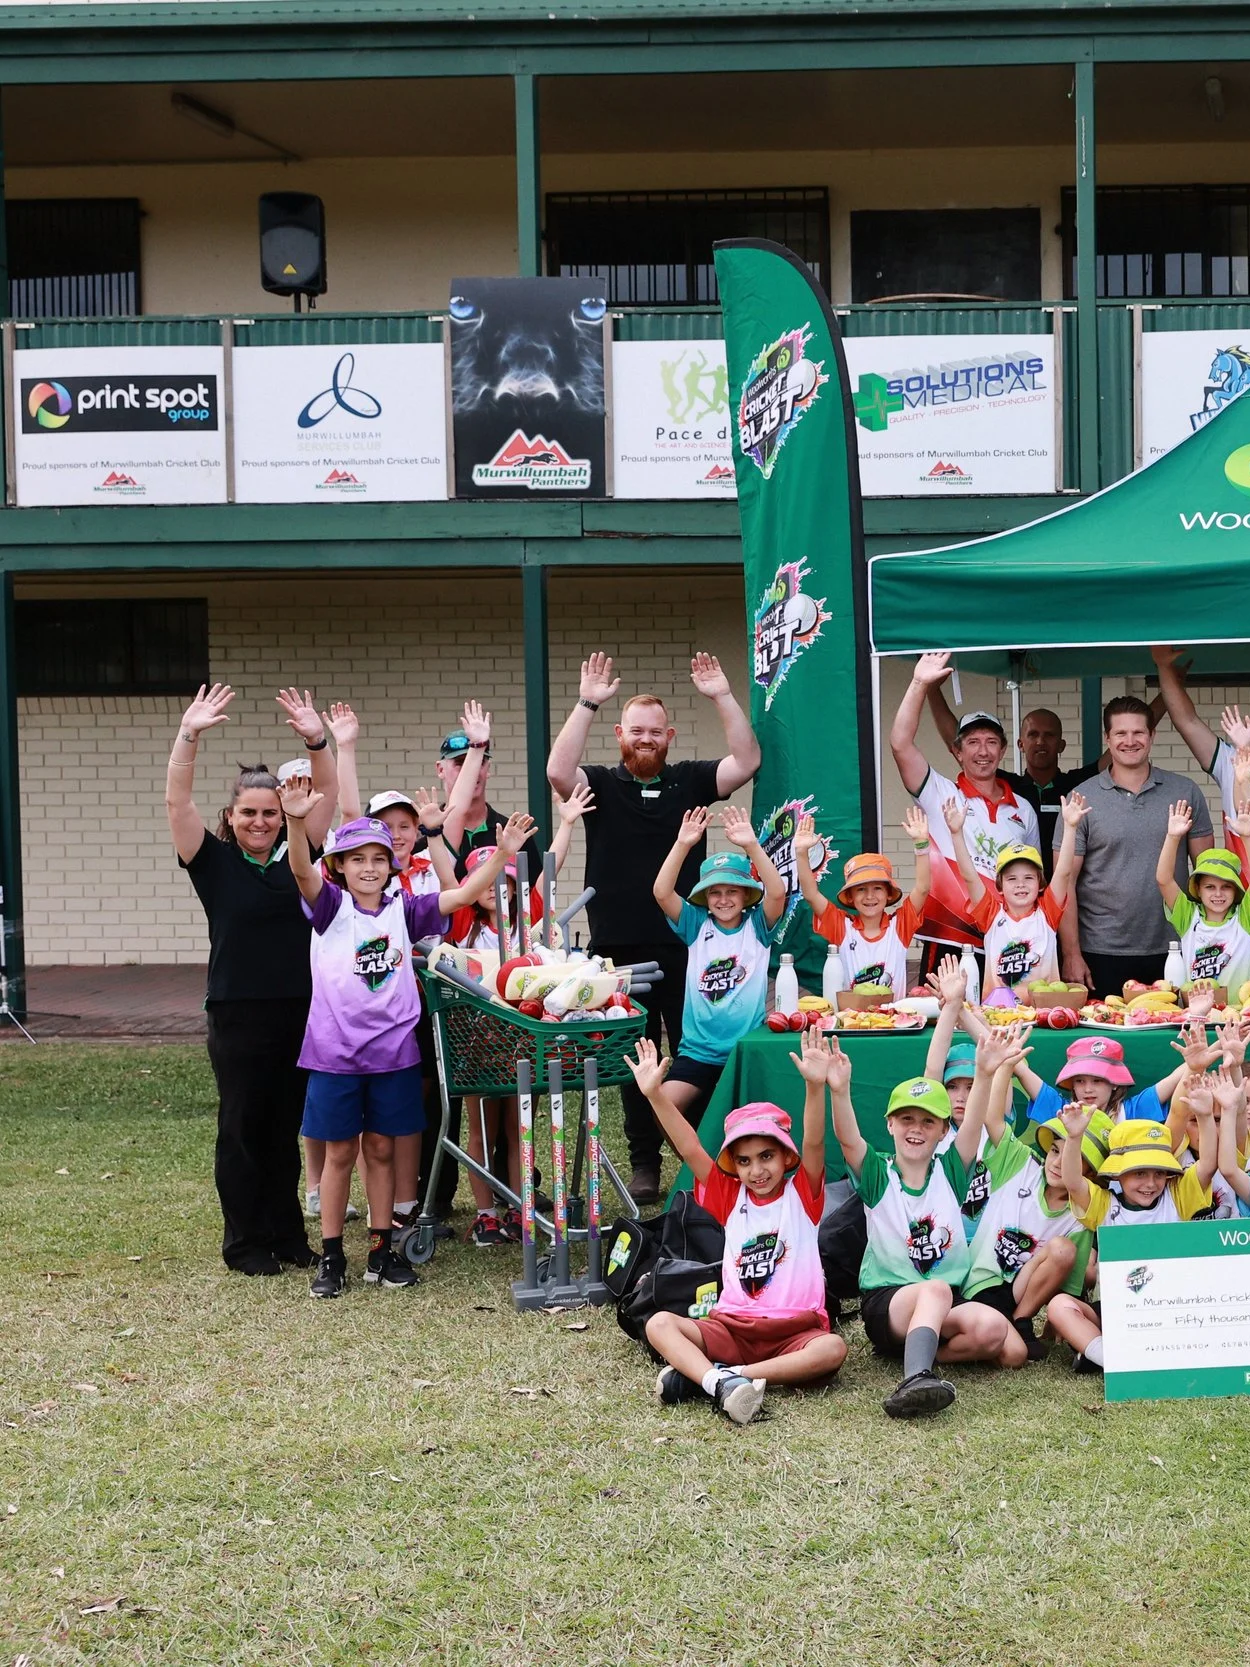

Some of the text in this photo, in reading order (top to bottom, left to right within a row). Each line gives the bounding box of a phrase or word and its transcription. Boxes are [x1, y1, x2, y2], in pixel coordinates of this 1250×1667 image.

[886, 357, 1044, 396] SOLUTIONS
[744, 372, 787, 419] CRICKET
[902, 372, 1047, 410] MEDICAL
[77, 383, 210, 415] print spot
[168, 409, 210, 423] group
[889, 393, 1048, 424] QUALITY PRECISION TECHNOLOGY
[740, 384, 803, 451] BLAST
[297, 432, 381, 440] MURWILLUMBAH
[656, 427, 703, 440] Pace
[621, 455, 647, 463] Proud
[649, 455, 691, 463] sponsors
[693, 454, 701, 462] of
[873, 451, 914, 460] sponsors
[916, 450, 925, 458] of
[927, 450, 991, 458] Murwillumbah
[993, 449, 1026, 457] Cricket
[1028, 448, 1048, 457] Club
[22, 459, 221, 470] Proud sponsors of Murwillumbah Cricket Club
[241, 460, 268, 468] Proud
[270, 460, 310, 468] sponsors
[323, 457, 385, 466] Murwillumbah
[387, 457, 418, 465] Cricket
[420, 456, 441, 465] Club
[476, 466, 587, 478] Murwillumbah
[531, 478, 587, 486] Panthers
[354, 959, 394, 974] BLAST
[997, 960, 1032, 975] BLAST
[1191, 961, 1223, 980] BLAST
[698, 975, 738, 991] BLAST
[521, 1140, 532, 1220] playcricket.com.au
[554, 1139, 565, 1220] playcricket.com.au
[590, 1135, 600, 1216] playcricket.com.au
[965, 1184, 991, 1203] AST
[1143, 1294, 1217, 1306] Murwillumbah
[1174, 1313, 1205, 1328] Fifty
